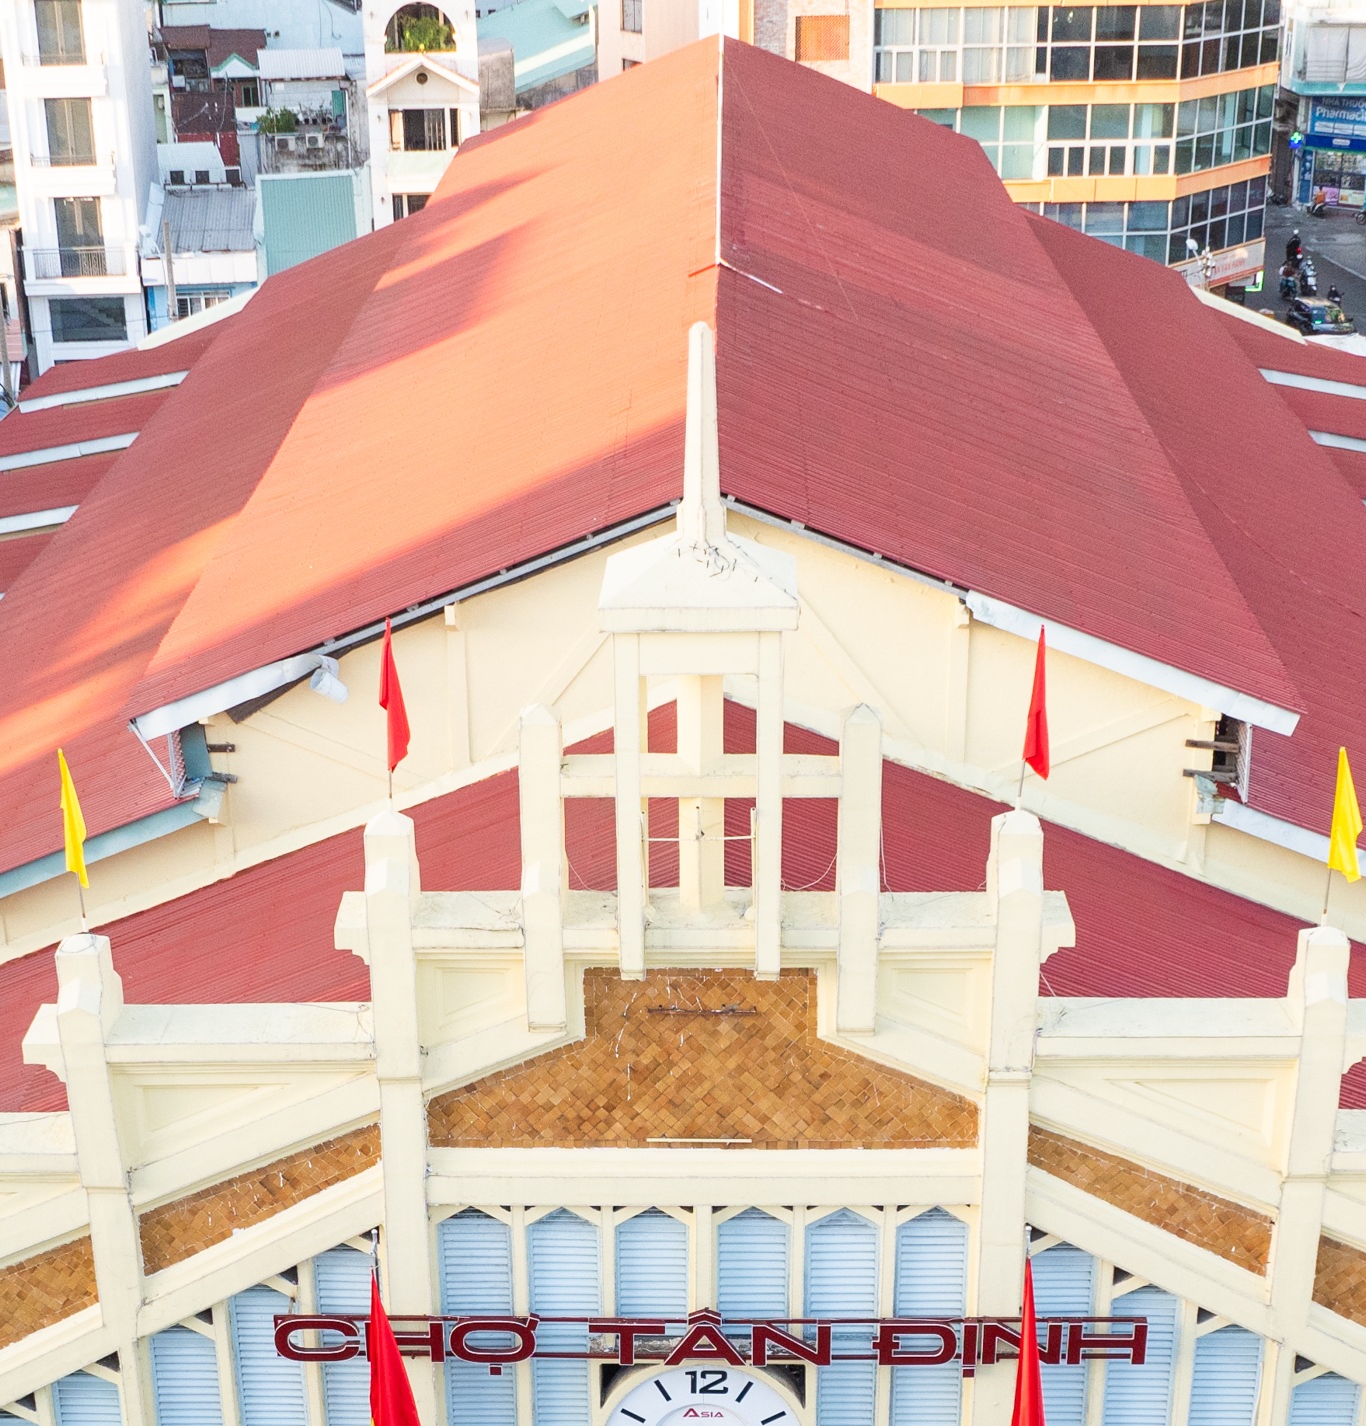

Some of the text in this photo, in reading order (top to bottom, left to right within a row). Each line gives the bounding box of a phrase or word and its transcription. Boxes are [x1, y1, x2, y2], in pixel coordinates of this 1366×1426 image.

[274, 1307, 1149, 1378] CHỢ TÂN ĐỊNH
[685, 1370, 728, 1394] 12
